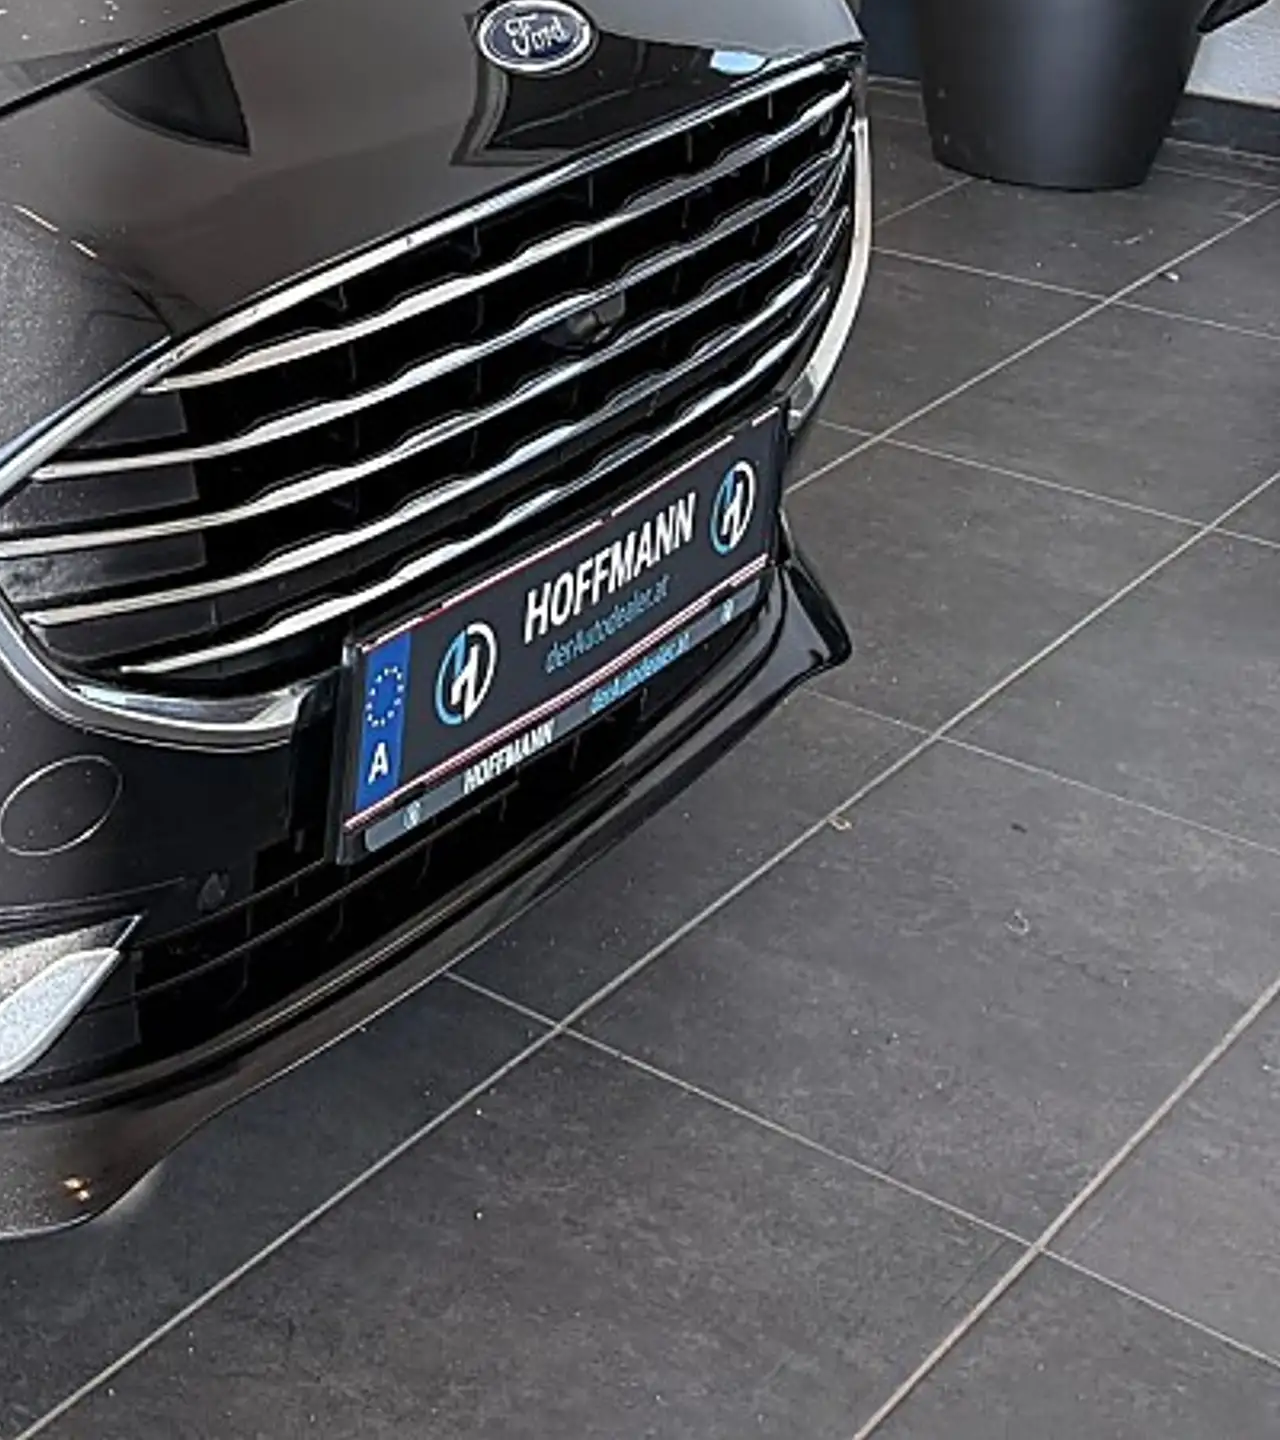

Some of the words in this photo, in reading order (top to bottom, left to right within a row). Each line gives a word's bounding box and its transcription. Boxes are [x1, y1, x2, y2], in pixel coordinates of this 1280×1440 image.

[505, 13, 571, 56] Ford
[524, 492, 696, 645] HOFFMANN
[367, 742, 389, 785] A
[463, 717, 556, 796] HOFFMANN
